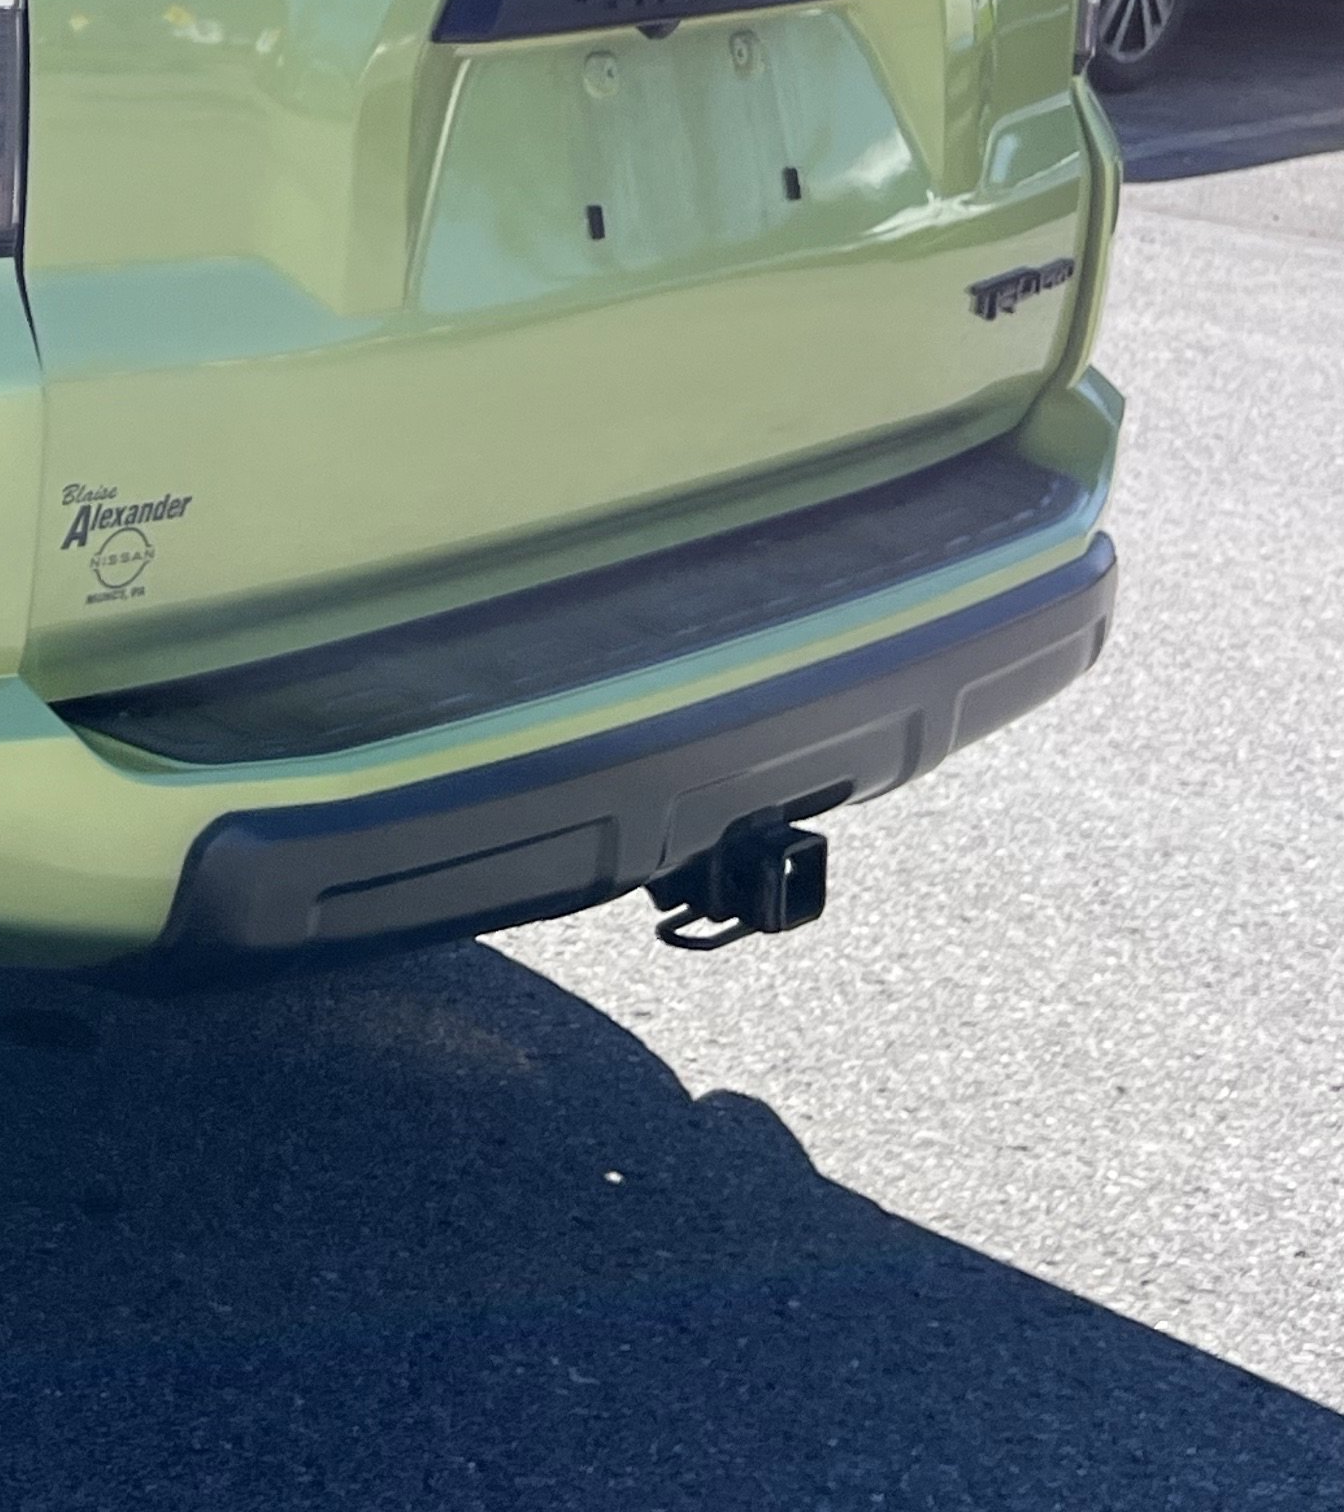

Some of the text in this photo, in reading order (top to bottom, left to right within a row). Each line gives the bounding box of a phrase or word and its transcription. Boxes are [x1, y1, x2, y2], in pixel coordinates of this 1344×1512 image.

[61, 483, 118, 507] Blaise
[60, 493, 193, 551] Alexander
[89, 548, 156, 569] NISSAN
